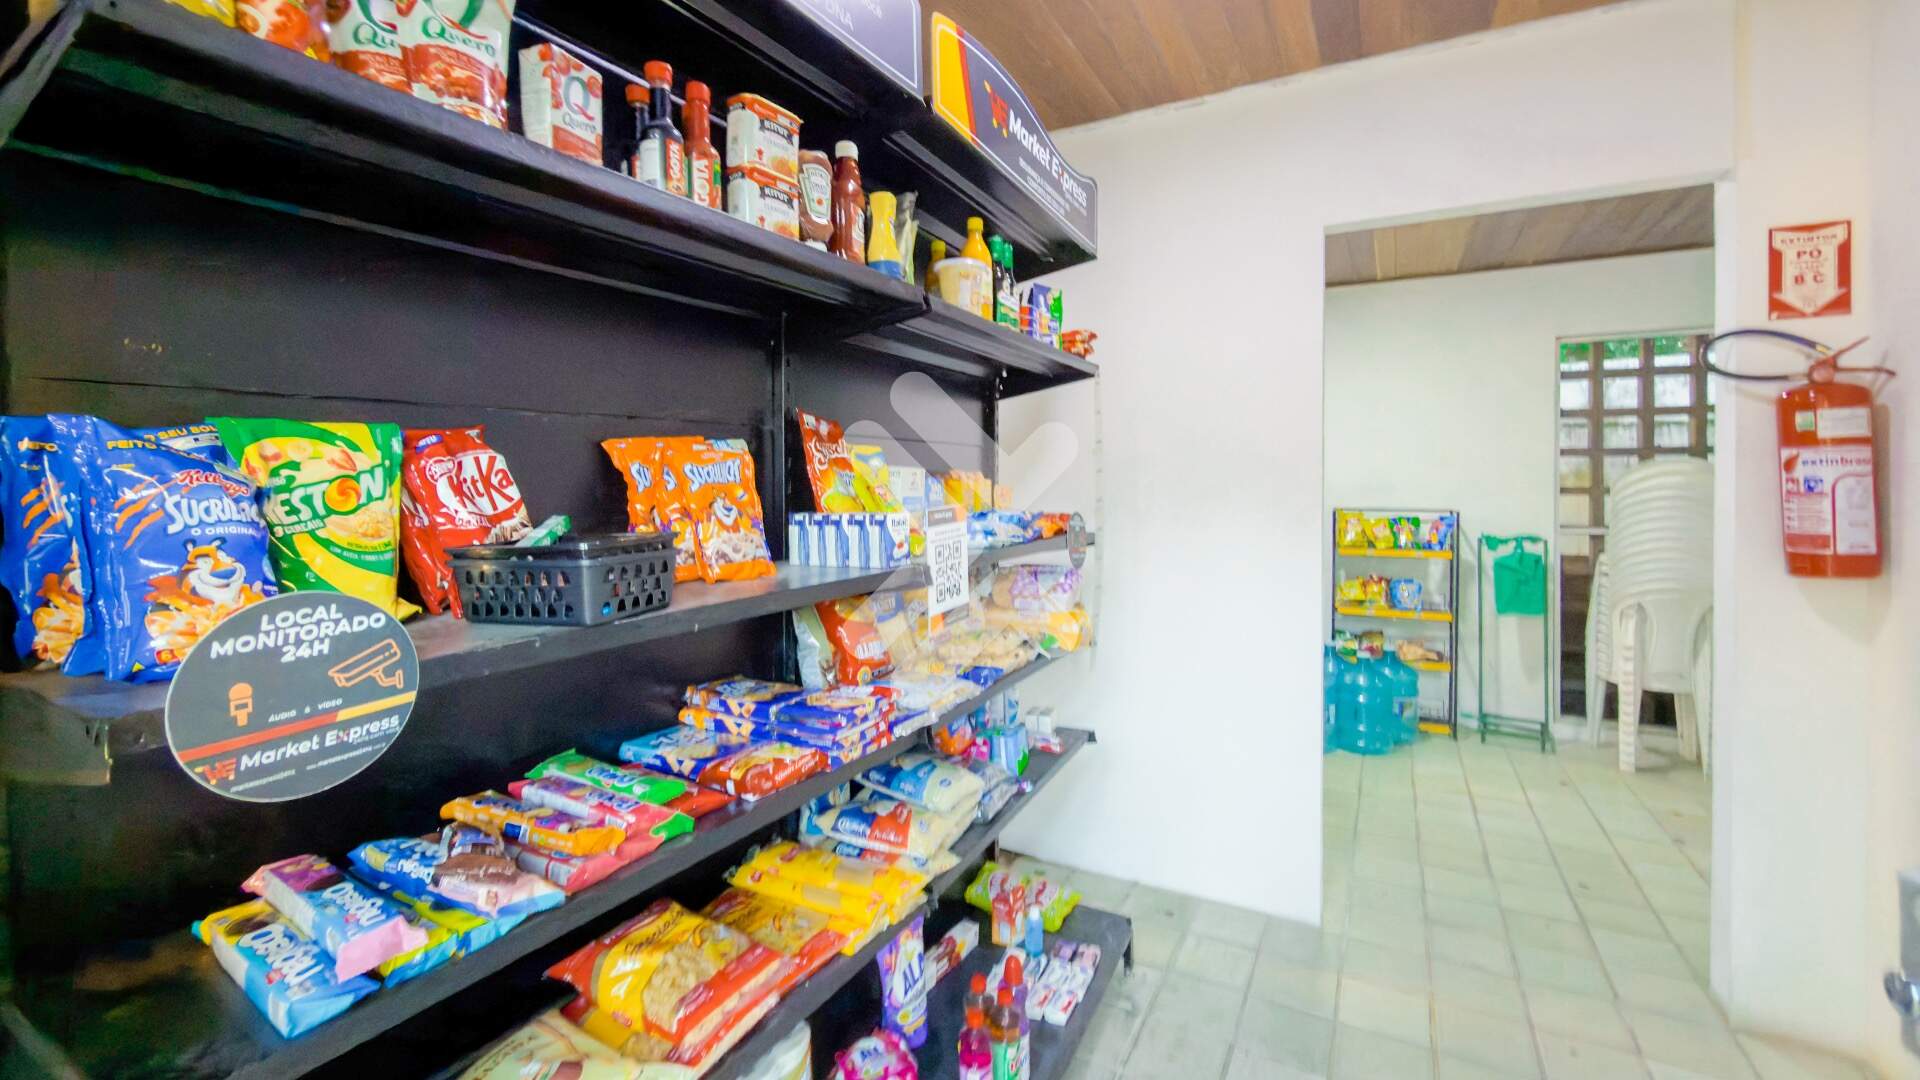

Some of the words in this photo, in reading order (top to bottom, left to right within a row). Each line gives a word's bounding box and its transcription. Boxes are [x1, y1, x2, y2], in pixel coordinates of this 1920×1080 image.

[421, 17, 496, 58] Quero
[562, 112, 598, 134] Quero
[1008, 108, 1051, 171] Market
[446, 455, 516, 512] KitKa
[210, 613, 386, 659] MONITORADO
[261, 604, 343, 631] LOCAL
[281, 637, 330, 663] 24H
[240, 735, 320, 772] Market
[325, 715, 400, 747] Express
